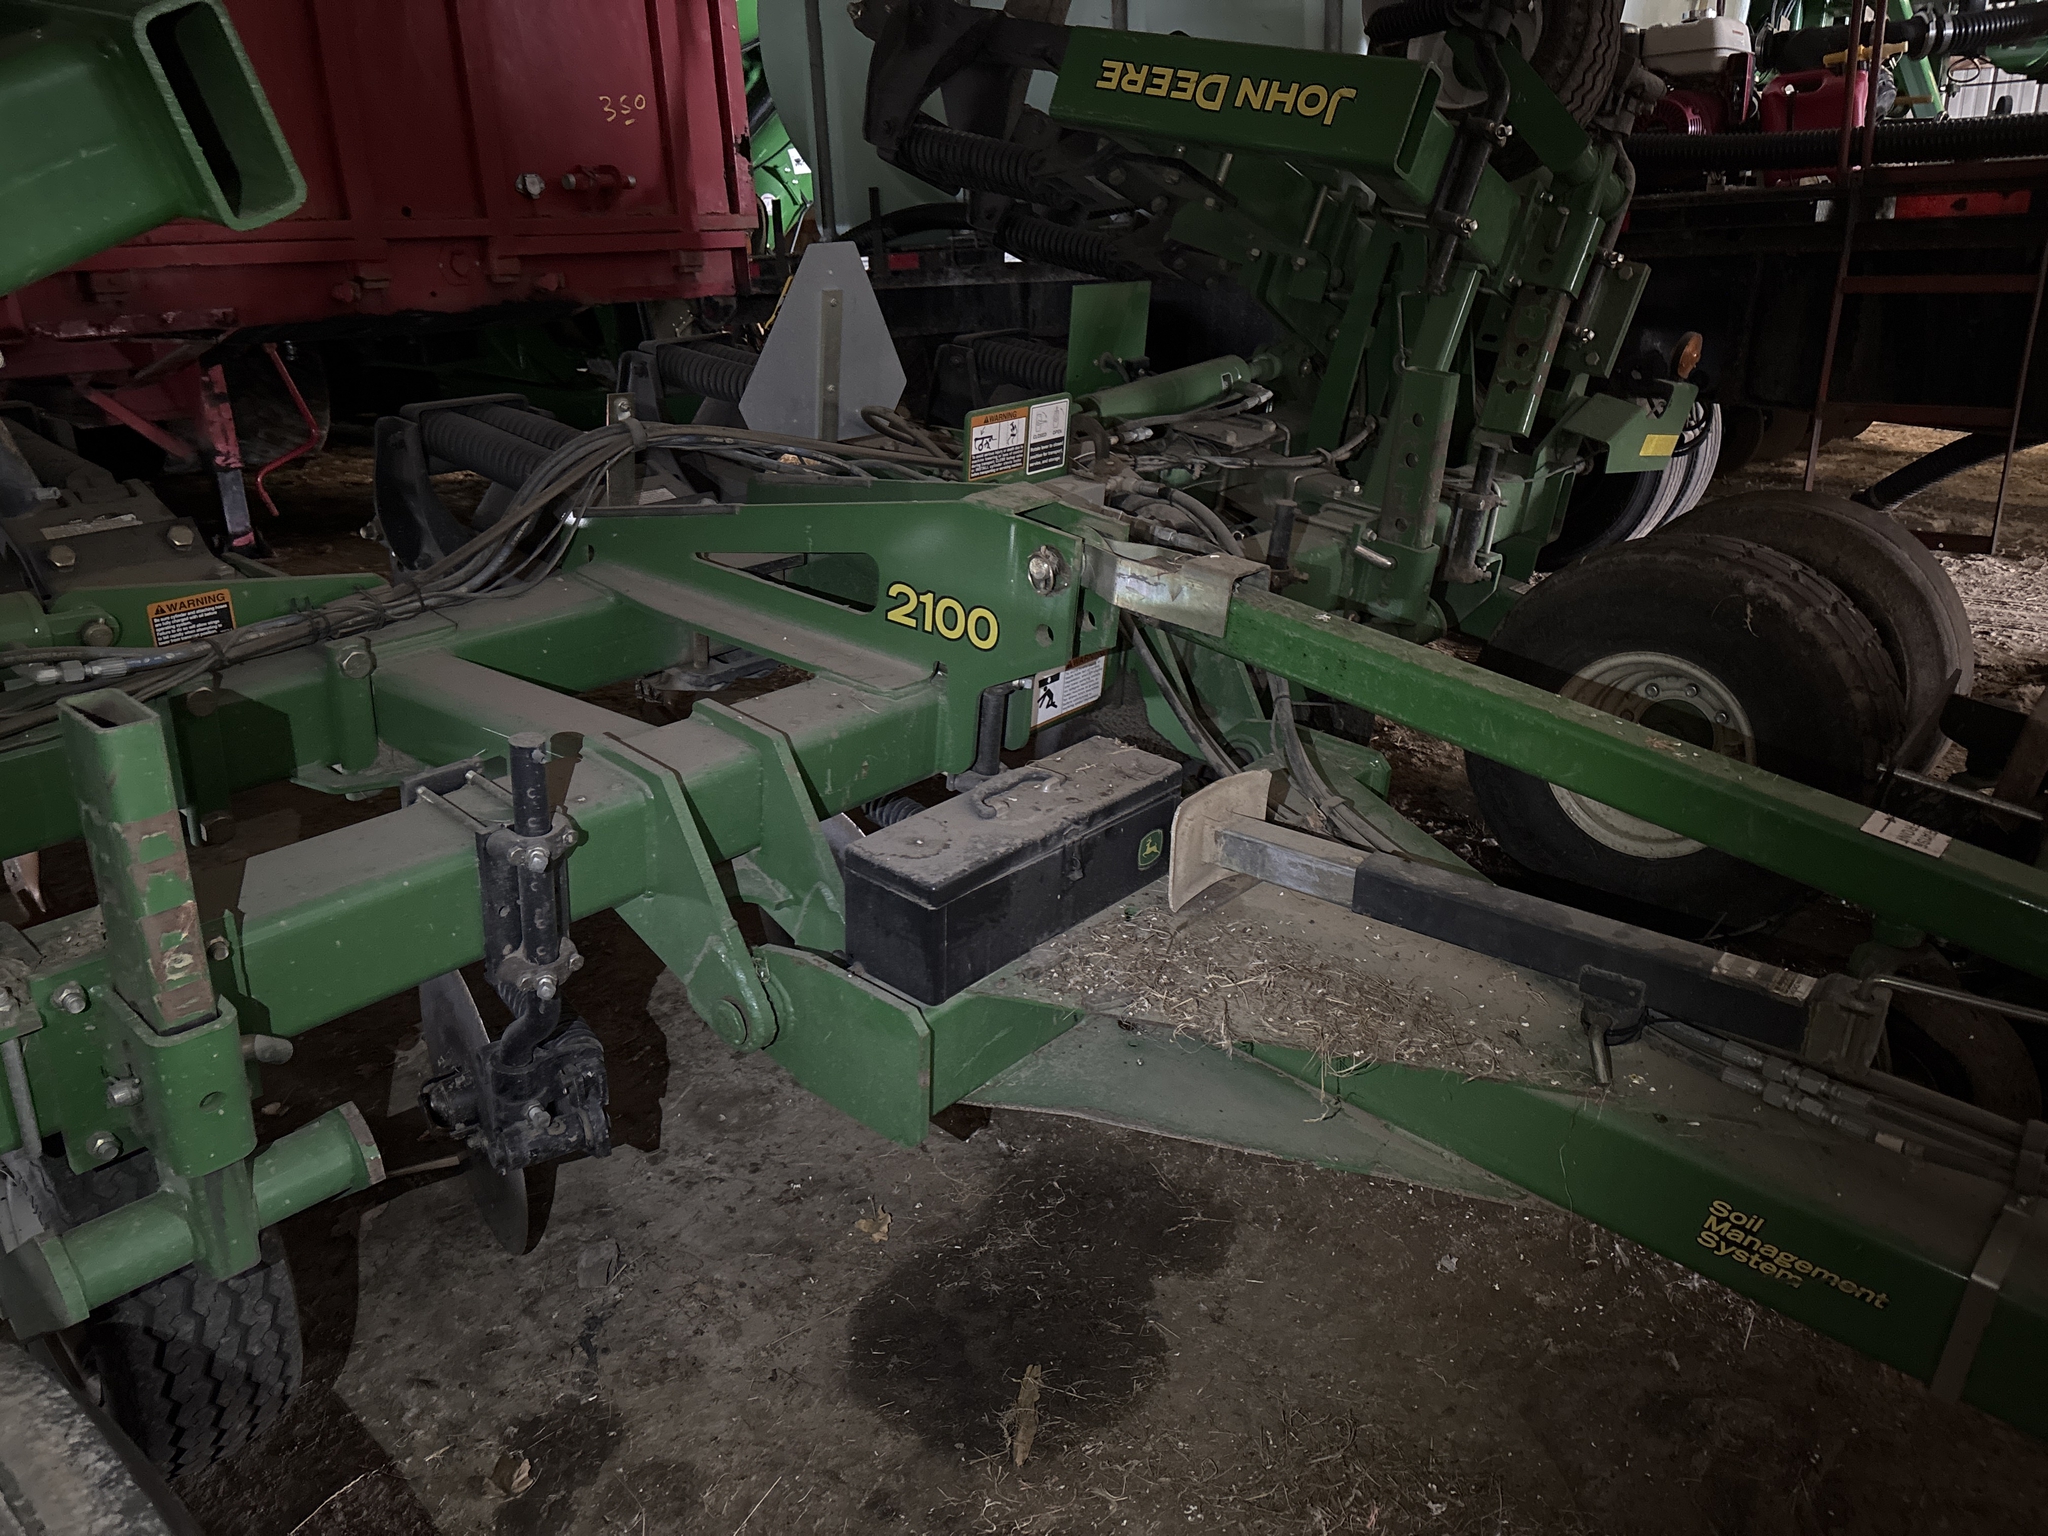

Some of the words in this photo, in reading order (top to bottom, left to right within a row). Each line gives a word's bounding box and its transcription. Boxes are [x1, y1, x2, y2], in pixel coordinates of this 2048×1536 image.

[1095, 58, 1231, 112] DEERE
[1233, 77, 1358, 127] JOHN
[988, 410, 1018, 421] WARNING
[166, 593, 226, 612] WARNING
[884, 581, 1000, 652] 2100
[1708, 1199, 1766, 1233] Soil
[1696, 1229, 1804, 1289] System
[1702, 1214, 1891, 1310] Management
